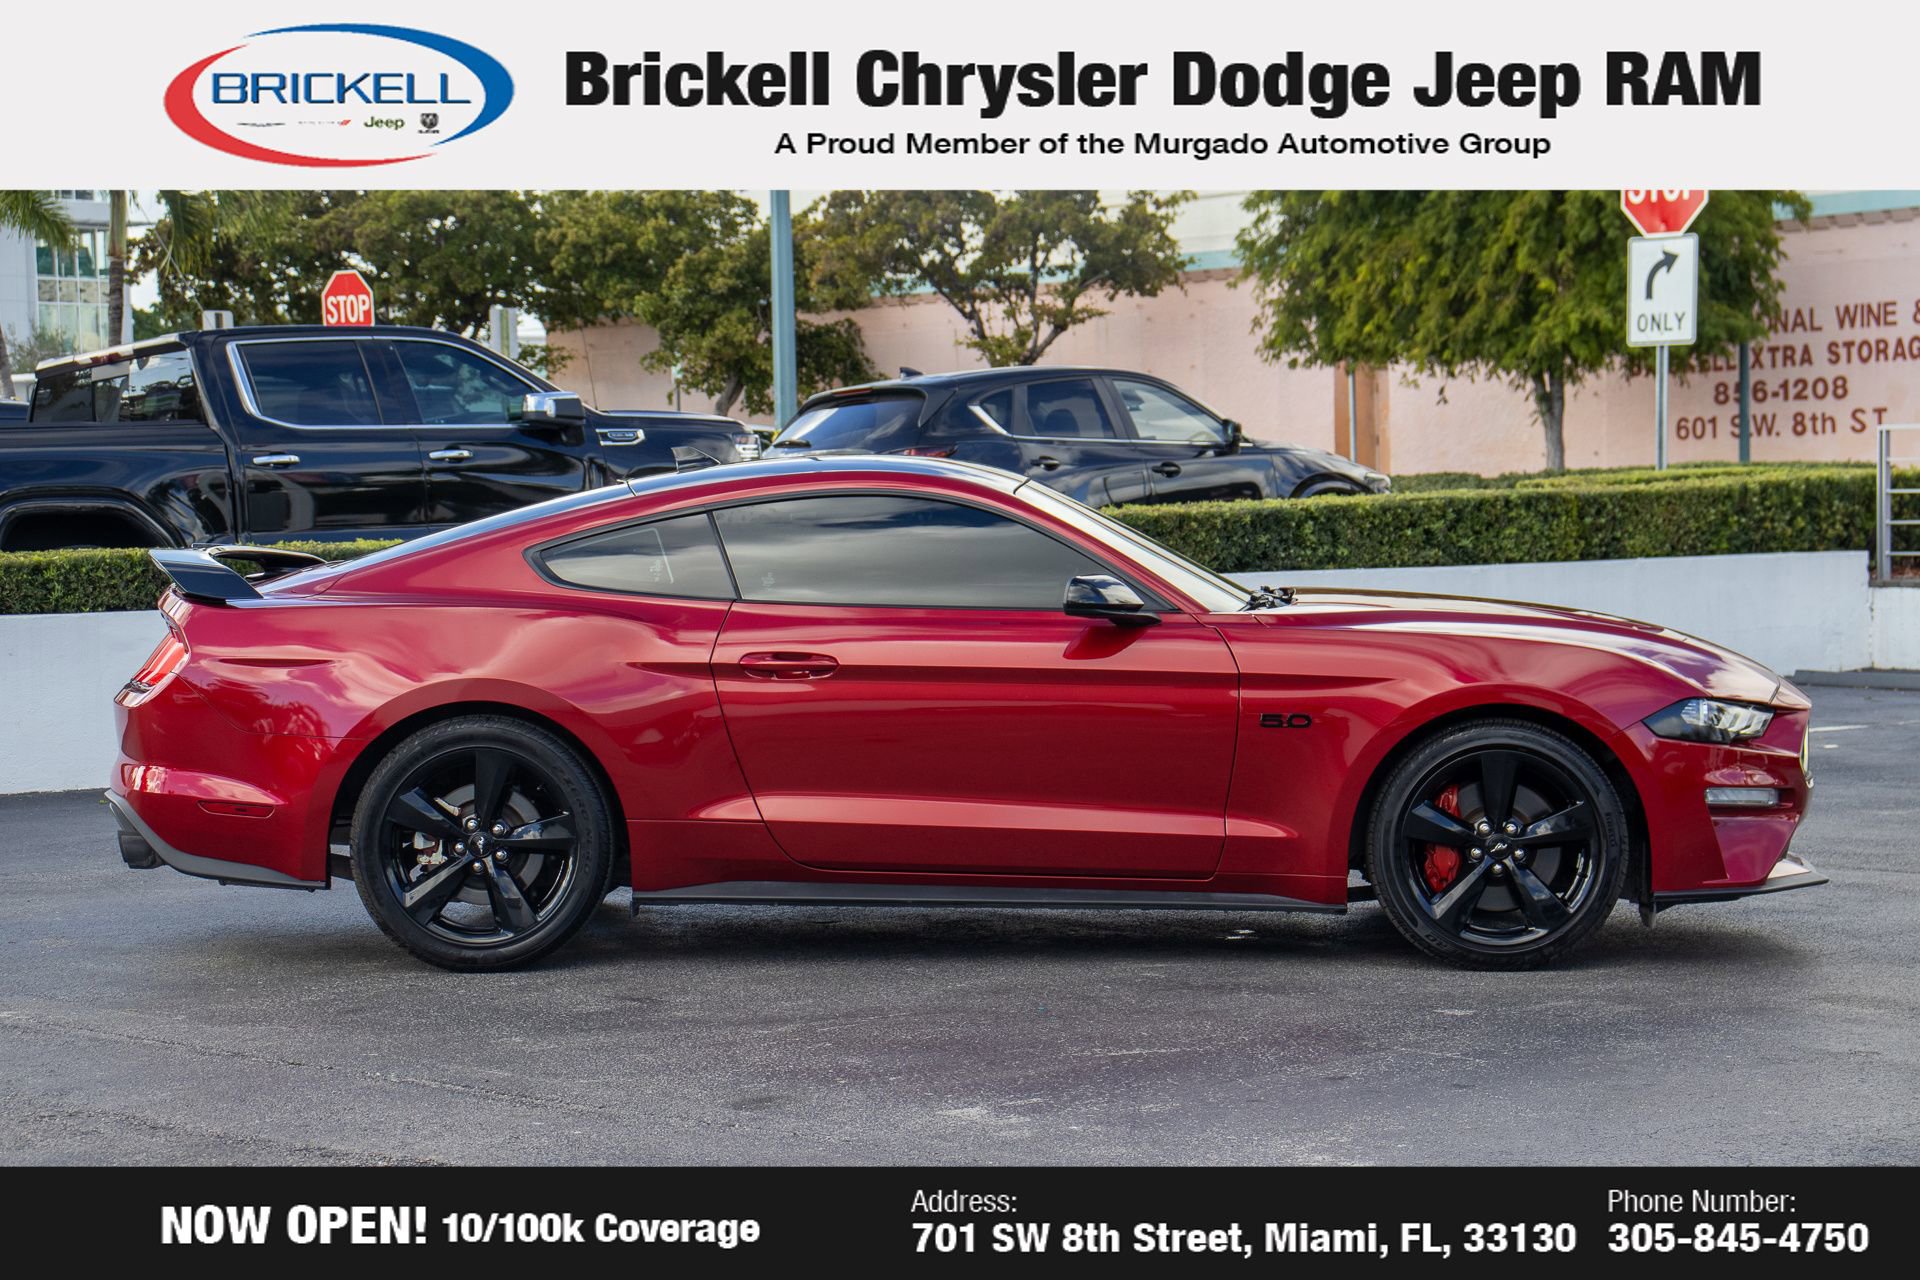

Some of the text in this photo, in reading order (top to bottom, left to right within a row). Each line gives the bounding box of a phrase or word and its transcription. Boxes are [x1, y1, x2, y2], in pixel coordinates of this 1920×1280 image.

[326, 294, 370, 324] STOP
[1636, 311, 1686, 333] ONLY
[1835, 301, 1897, 329] WINE
[1675, 416, 1718, 441] 601
[1792, 411, 1837, 437] 8th
[1260, 713, 1312, 728] 5.0
